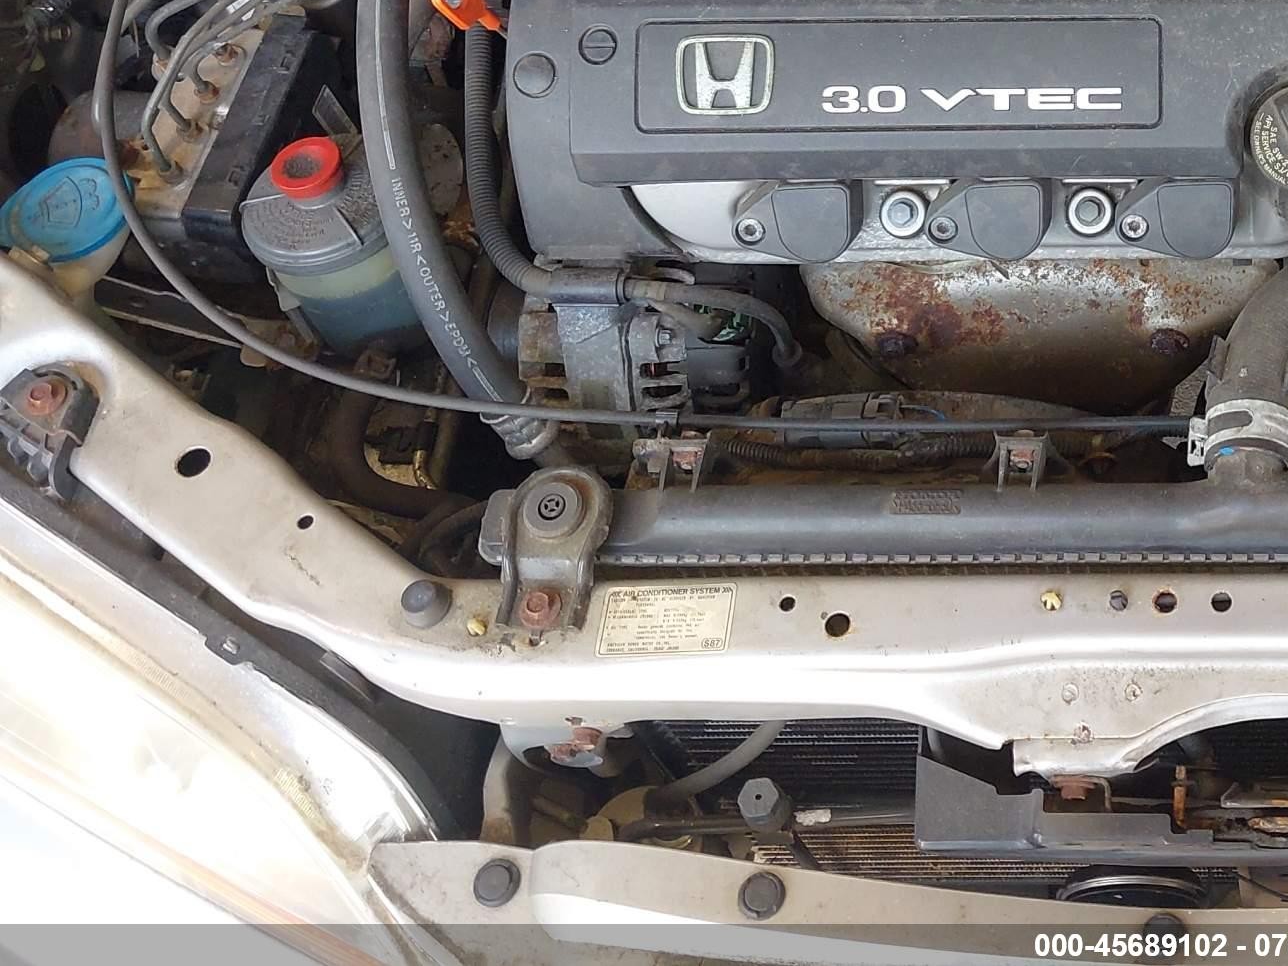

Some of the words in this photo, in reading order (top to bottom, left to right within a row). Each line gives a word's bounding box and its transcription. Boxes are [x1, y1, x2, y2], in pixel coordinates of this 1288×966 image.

[821, 85, 907, 114] 3.0
[919, 87, 1123, 112] VTEC
[1269, 125, 1277, 143] SAE
[1261, 130, 1275, 163] SERVICE
[1263, 163, 1286, 184] MANUAL
[637, 588, 688, 596] CONDITIONER
[689, 586, 720, 594] SYSTEM
